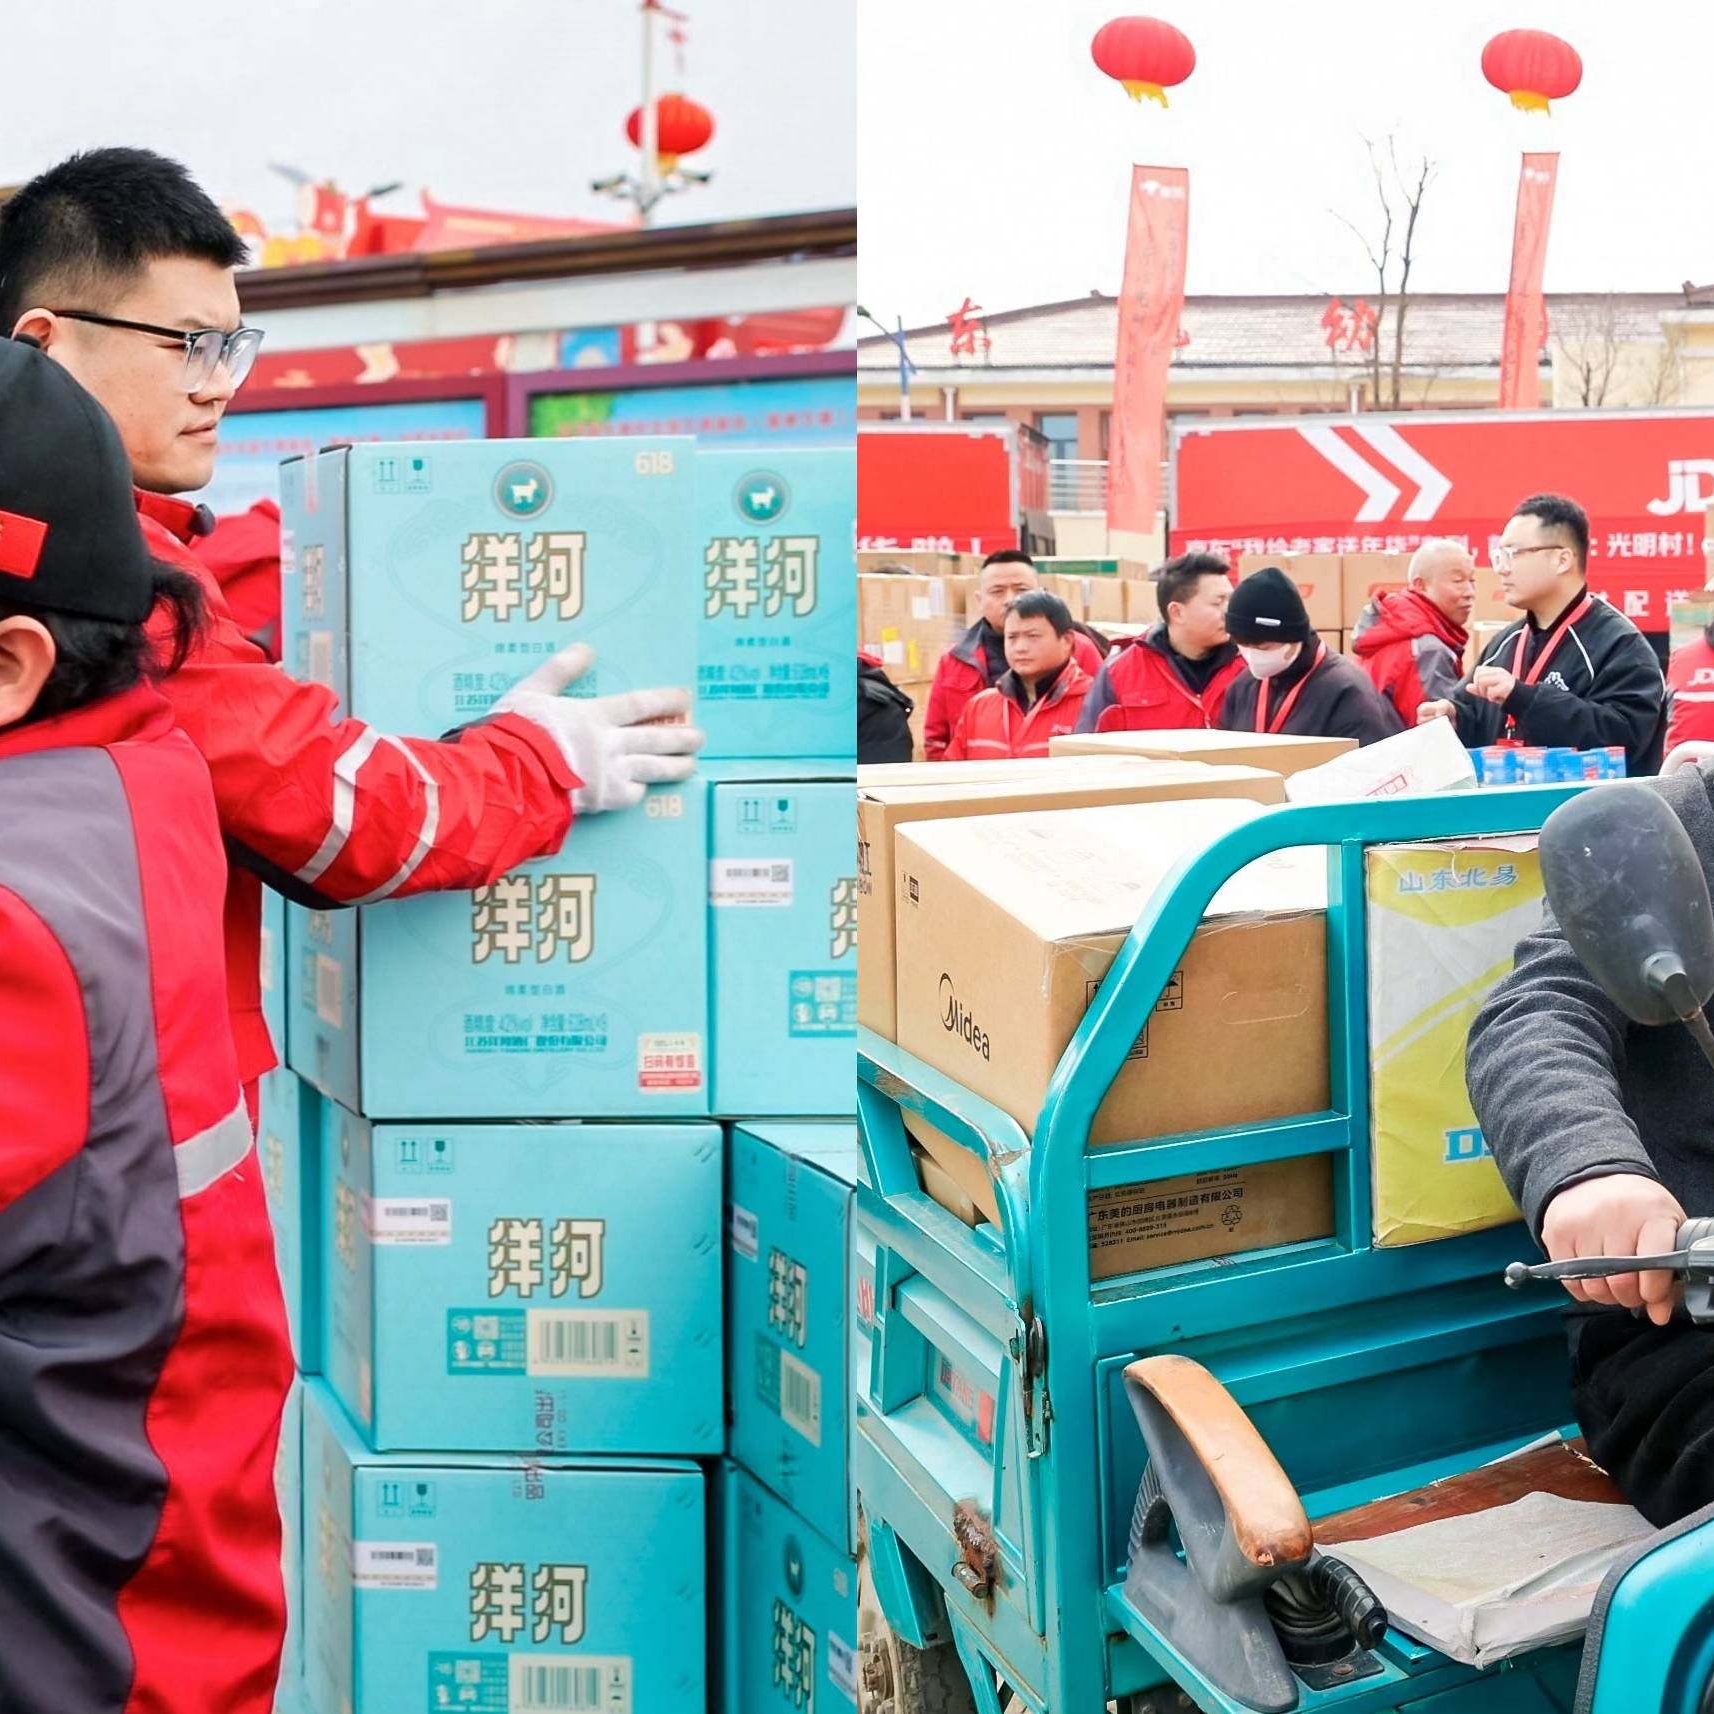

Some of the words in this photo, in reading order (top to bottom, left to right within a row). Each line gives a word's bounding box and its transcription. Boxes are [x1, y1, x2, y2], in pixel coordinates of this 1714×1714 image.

[635, 450, 674, 475] 618
[460, 531, 587, 623] 洋河
[703, 535, 820, 620] 洋河
[643, 795, 684, 818] 618
[472, 874, 598, 964] 洋河
[939, 978, 991, 1062] Midea
[1445, 1127, 1493, 1162] D
[487, 1217, 607, 1299] 洋河
[768, 1246, 807, 1350] 洋河
[469, 1562, 588, 1644] 洋河
[772, 1596, 817, 1714] 洋河
